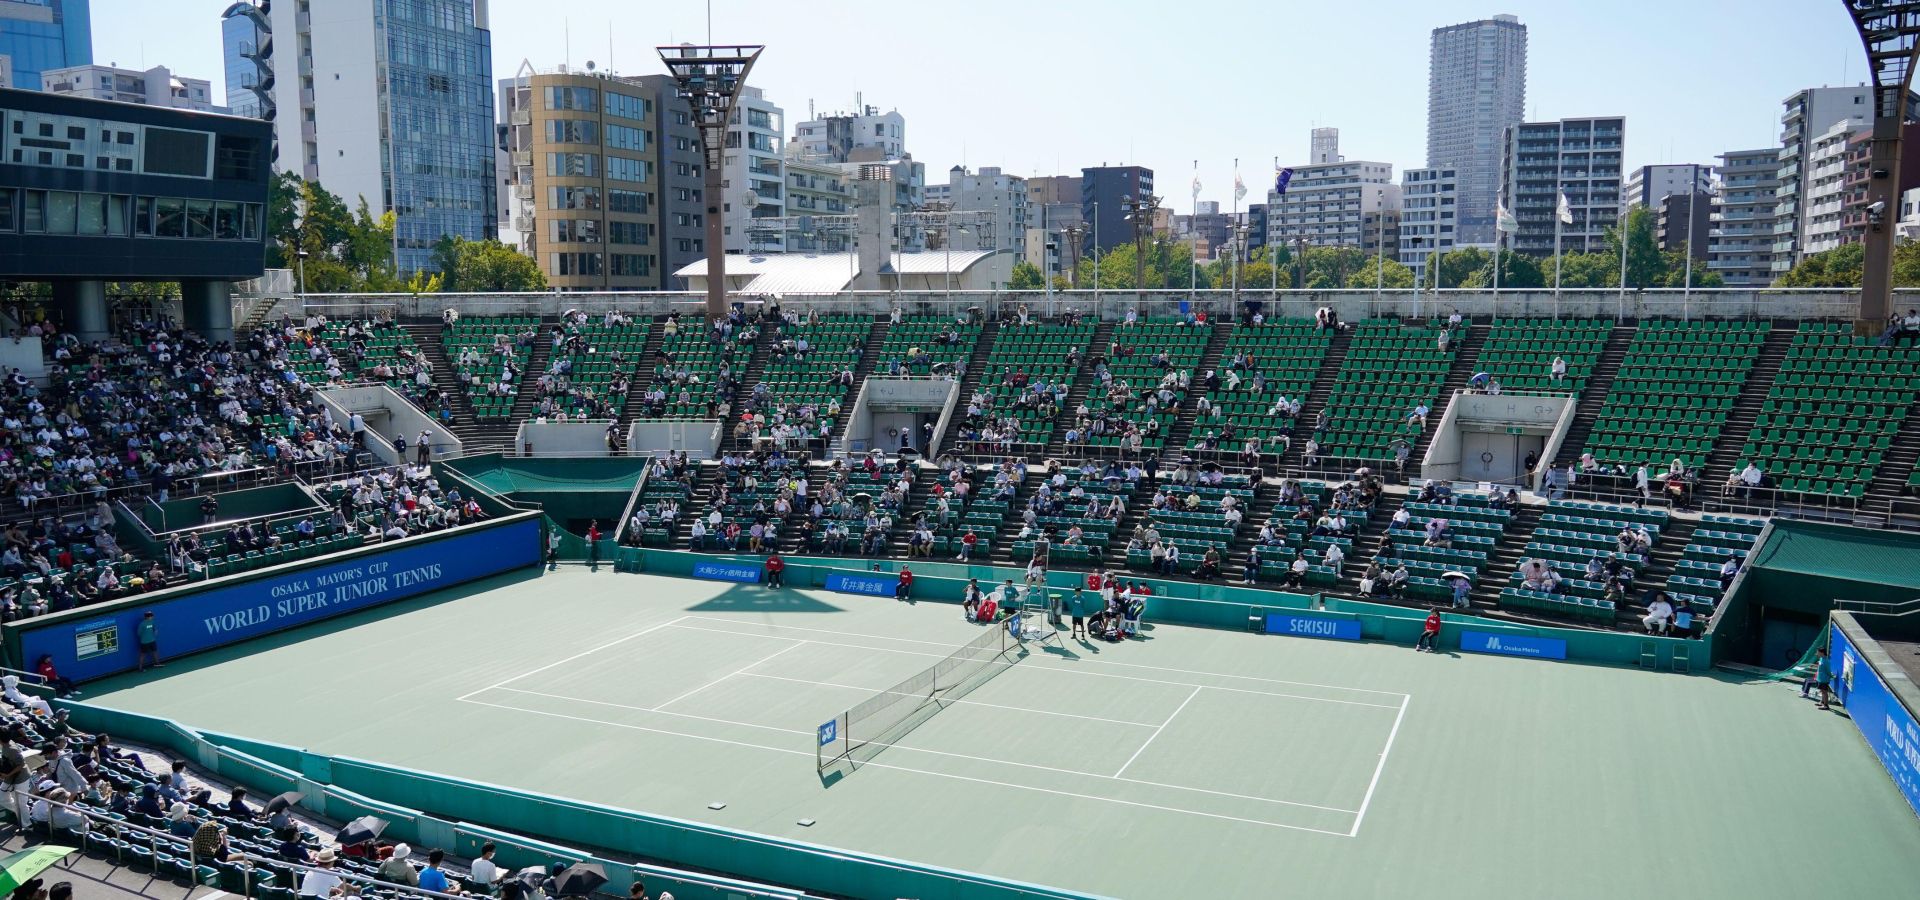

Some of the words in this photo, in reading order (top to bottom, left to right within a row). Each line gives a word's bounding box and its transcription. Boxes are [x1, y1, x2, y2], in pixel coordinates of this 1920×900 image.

[271, 580, 310, 598] OSAKA
[317, 567, 363, 588] MAYOR'S
[368, 561, 389, 574] CUP
[204, 605, 271, 635] WORLD
[277, 591, 328, 618] SUPER
[333, 577, 388, 604] JUNIOR
[393, 563, 442, 589] TENNIS
[1290, 618, 1337, 635] SEKISUI
